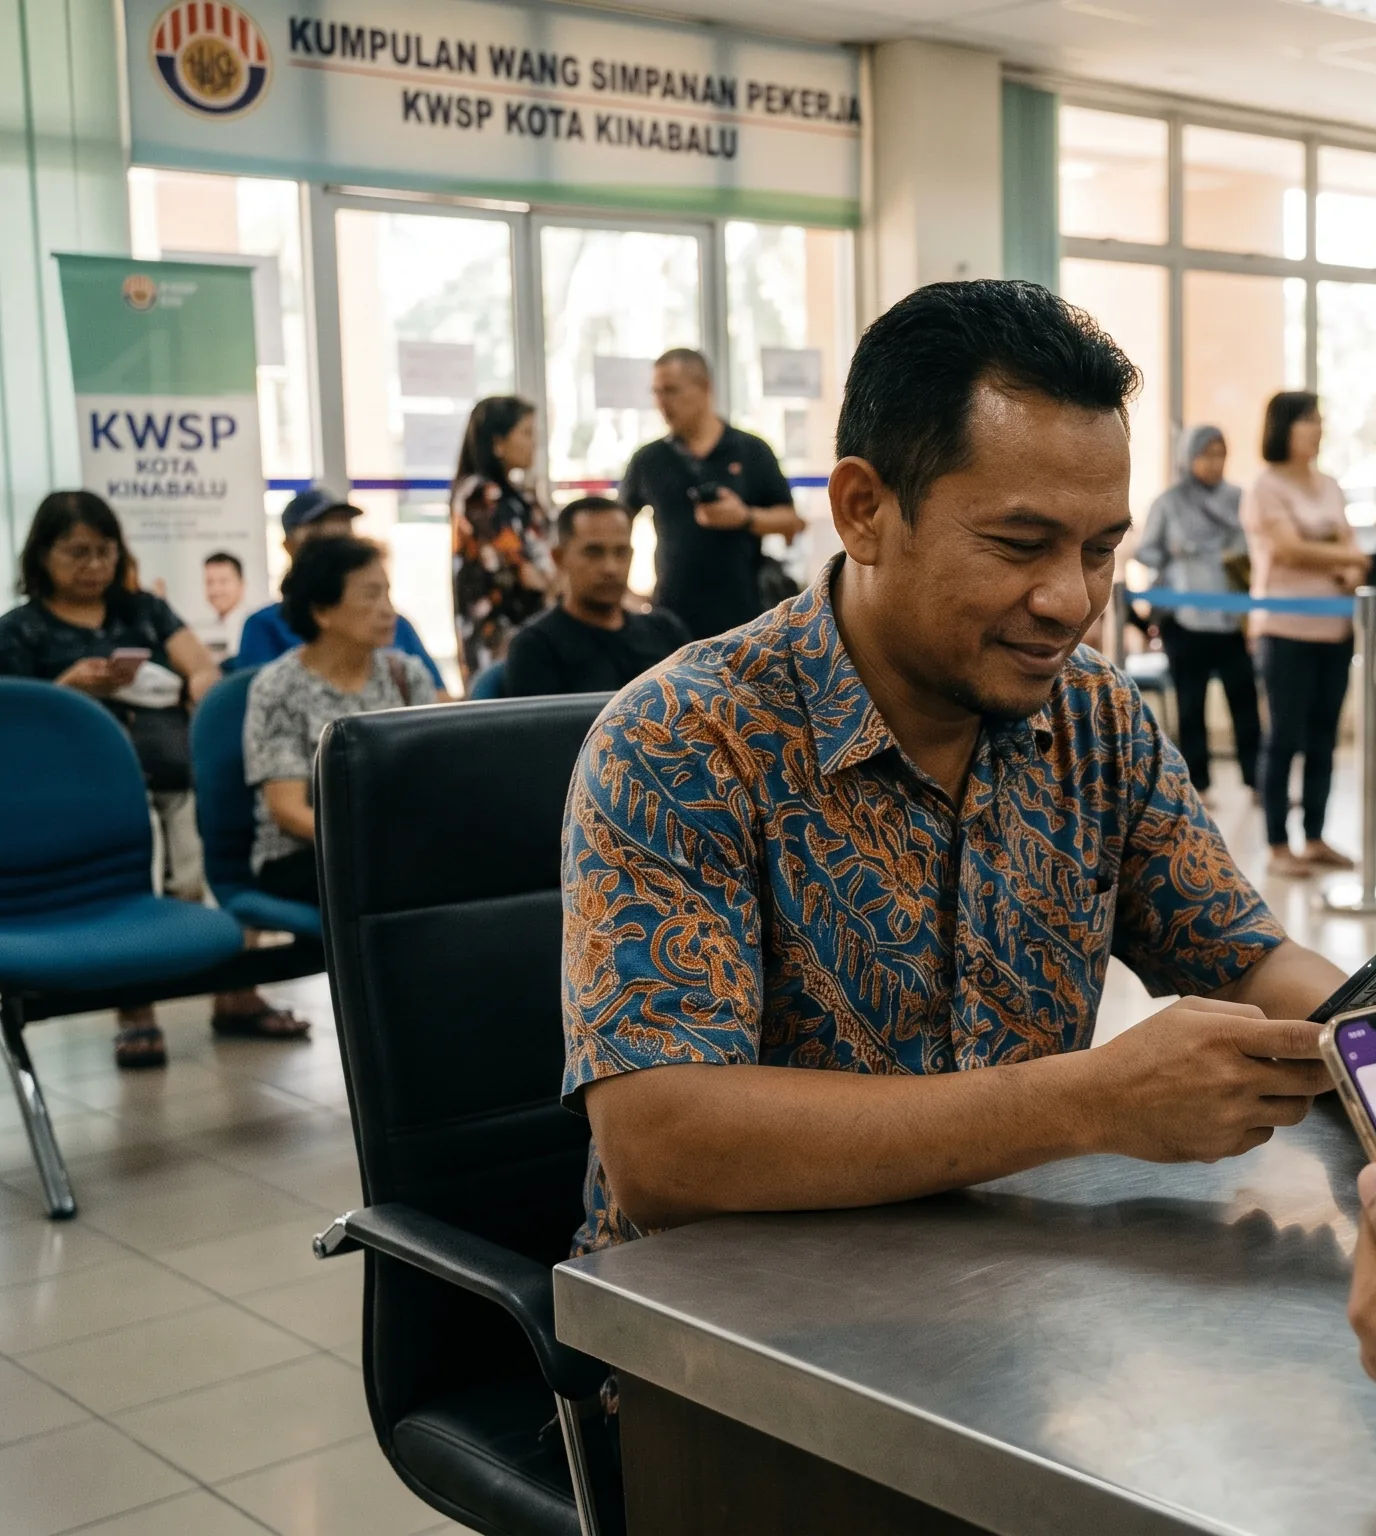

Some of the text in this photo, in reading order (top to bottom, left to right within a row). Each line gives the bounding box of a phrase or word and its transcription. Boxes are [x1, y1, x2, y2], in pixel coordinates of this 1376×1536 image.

[288, 17, 861, 126] KUMPULAN WANG SIMPANAN PEKERJA
[401, 89, 738, 159] KWSP KOTA KINABALU
[90, 411, 238, 451] KWSP
[136, 457, 198, 476] KOTA
[107, 479, 227, 499] KINABALU
